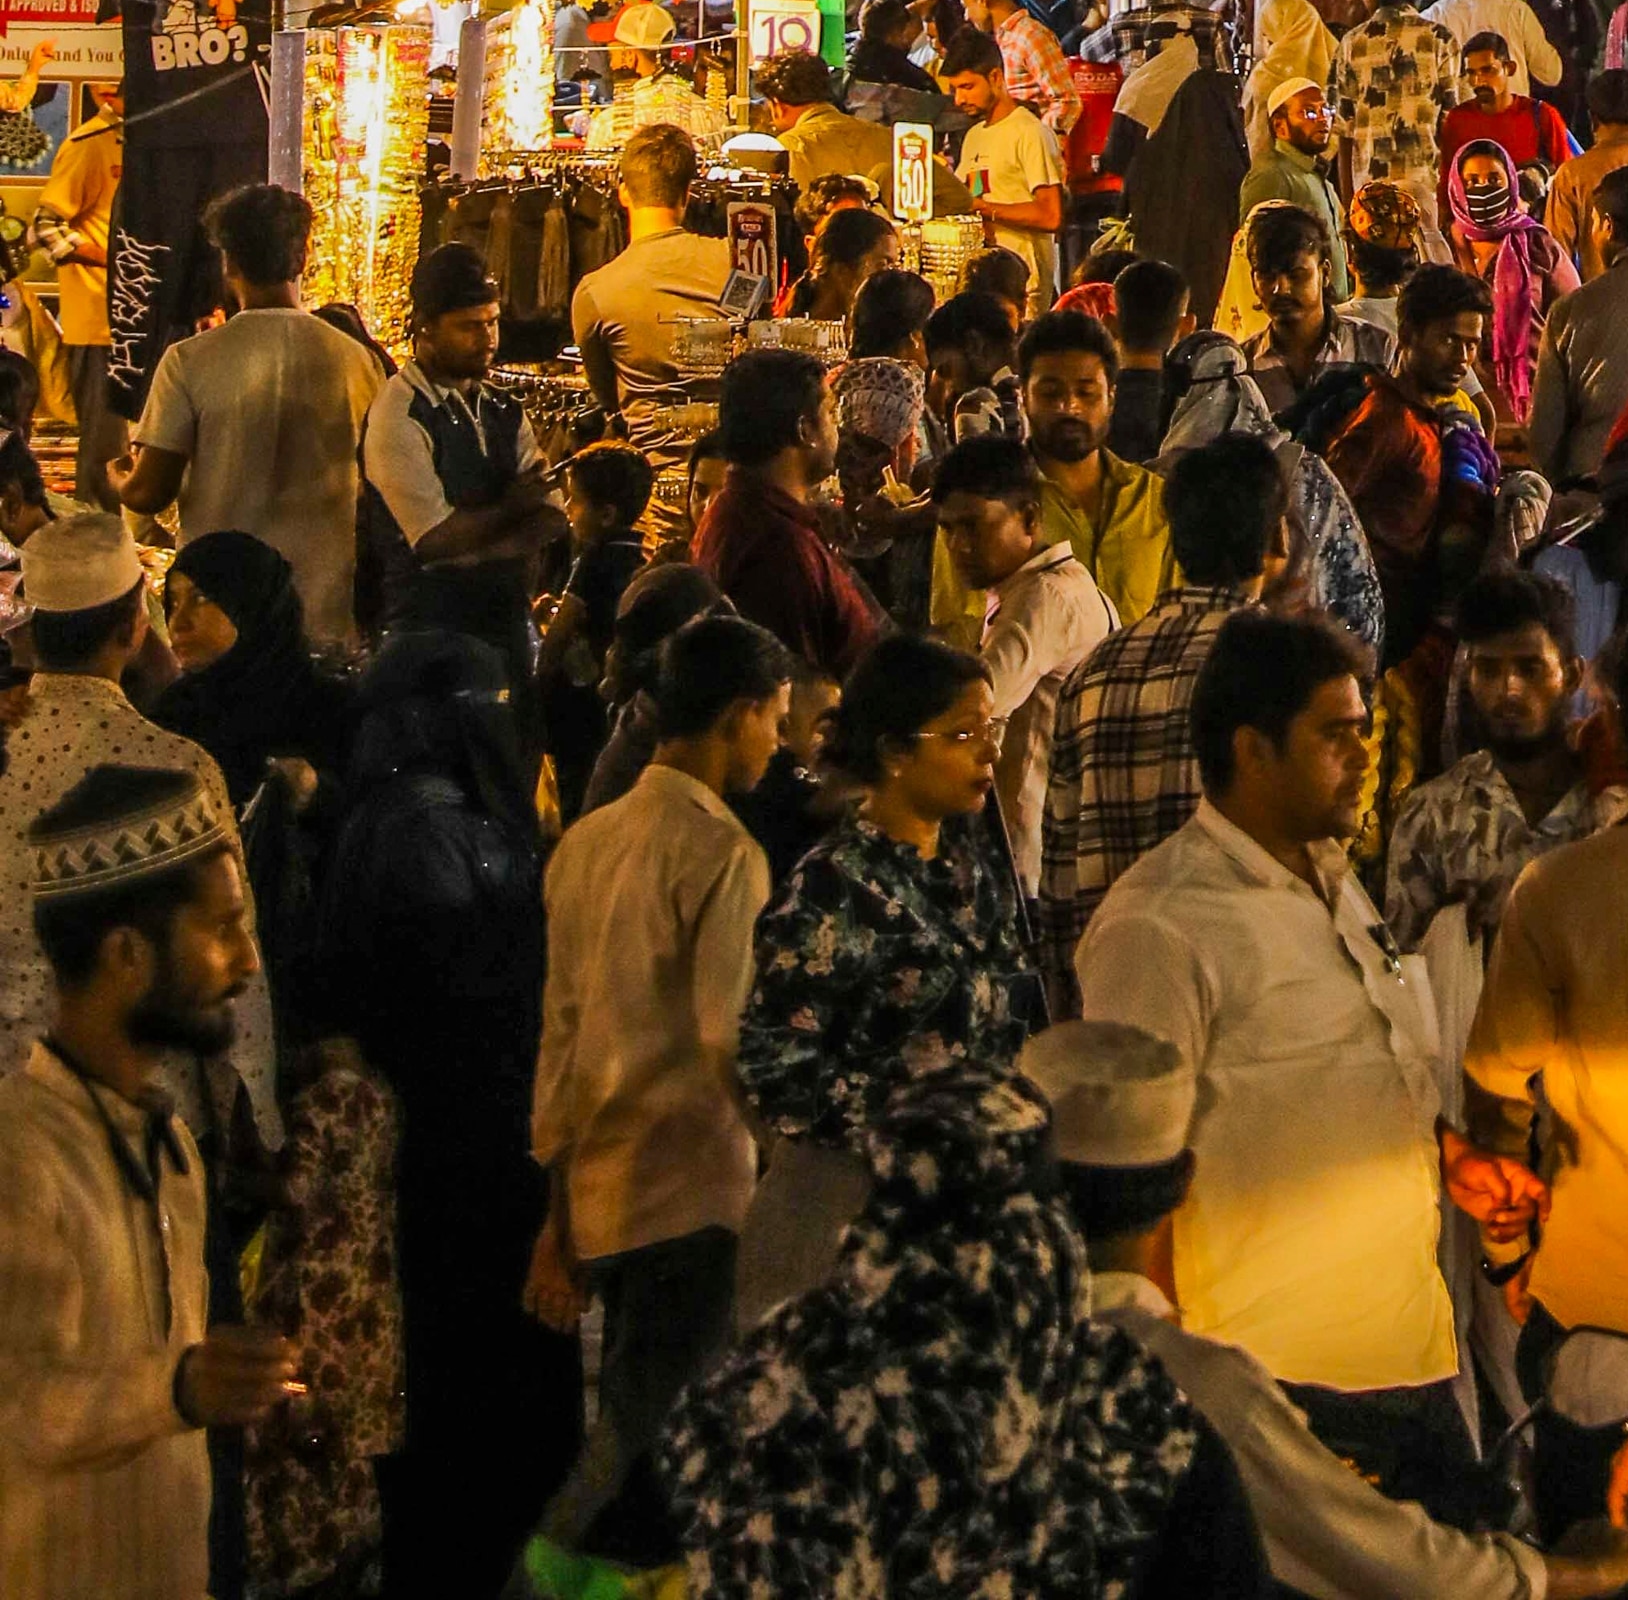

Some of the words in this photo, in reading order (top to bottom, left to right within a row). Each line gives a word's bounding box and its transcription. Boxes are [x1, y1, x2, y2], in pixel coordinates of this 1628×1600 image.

[86, 48, 114, 62] You
[151, 26, 249, 71] BRO?
[901, 158, 925, 208] 50
